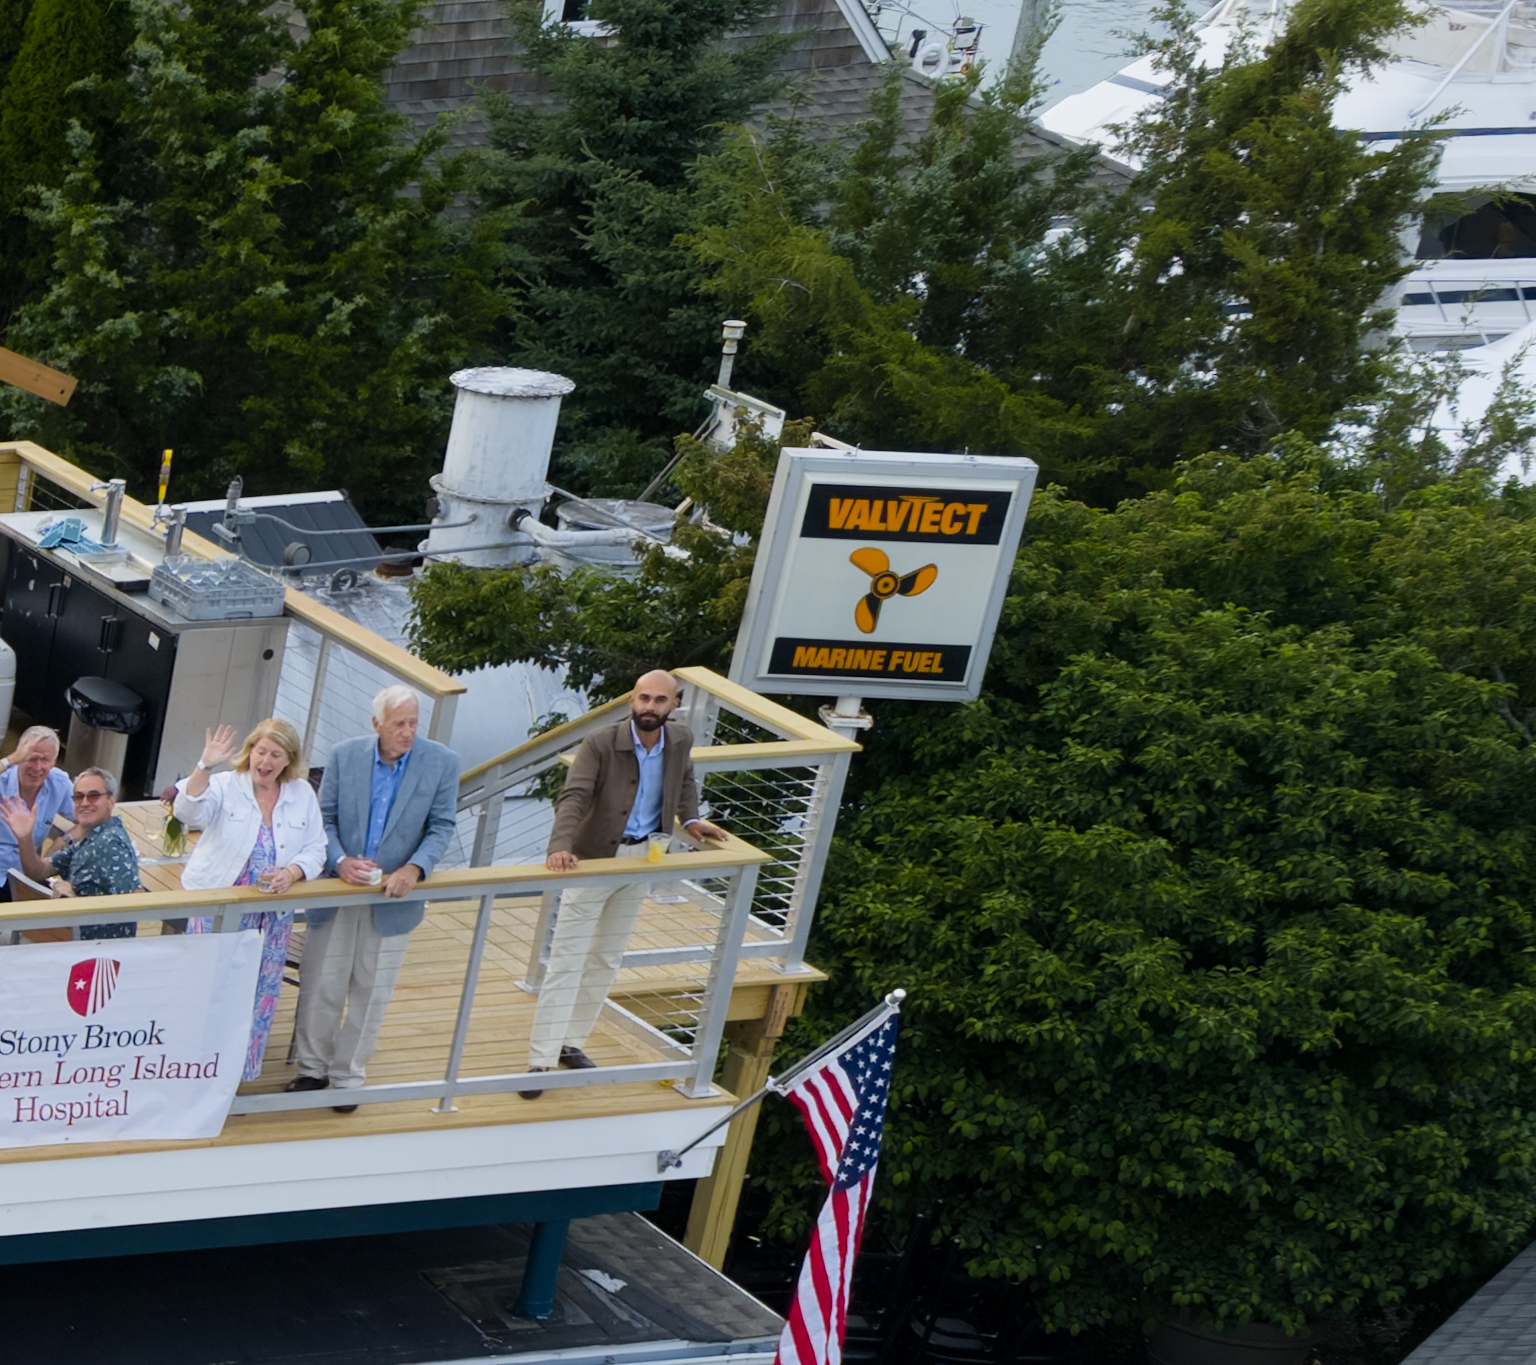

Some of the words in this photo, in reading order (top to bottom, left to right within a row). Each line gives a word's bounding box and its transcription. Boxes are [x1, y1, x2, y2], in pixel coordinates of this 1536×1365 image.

[828, 496, 989, 536] VALVTECT
[793, 646, 887, 671] MARINE
[888, 651, 944, 674] FUEL
[81, 1020, 166, 1050] Brook
[51, 1061, 126, 1088] Long
[130, 1053, 220, 1081] Island
[12, 1090, 129, 1126] Hospital
